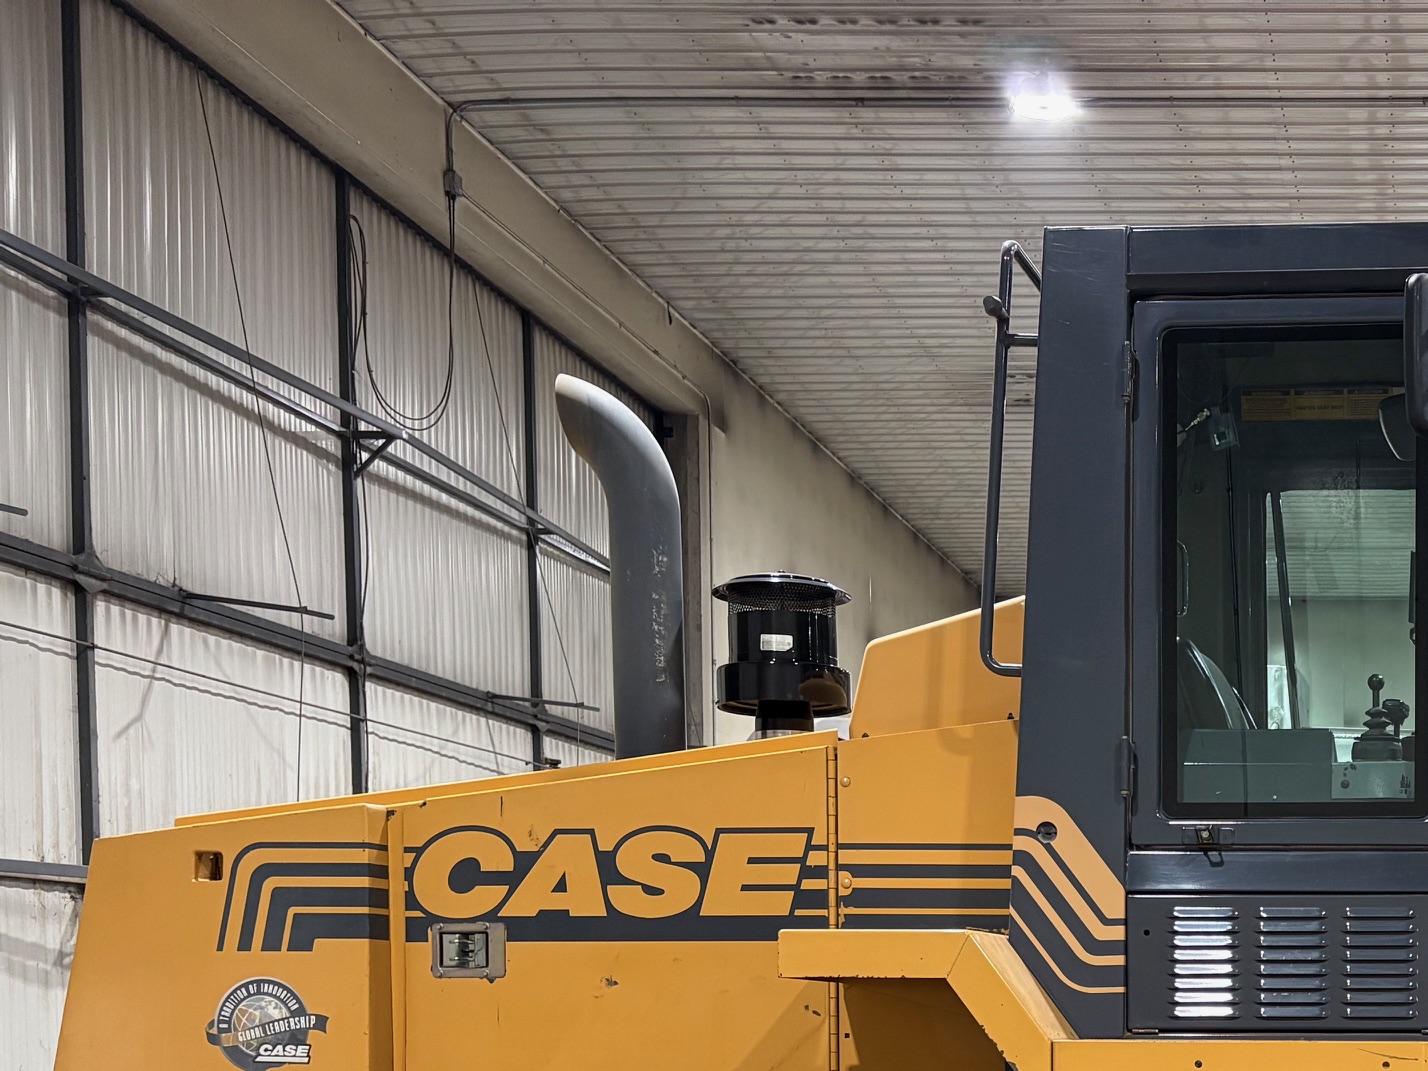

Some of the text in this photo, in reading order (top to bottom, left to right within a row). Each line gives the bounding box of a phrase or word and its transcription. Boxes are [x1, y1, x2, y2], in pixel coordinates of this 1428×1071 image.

[412, 829, 811, 919] CASE
[220, 986, 248, 1021] TRADITION
[248, 983, 258, 995] OF
[260, 982, 300, 1012] INNOVATION
[238, 1015, 316, 1042] GLOBAL LEADERSHIP
[258, 1044, 310, 1057] CASE
